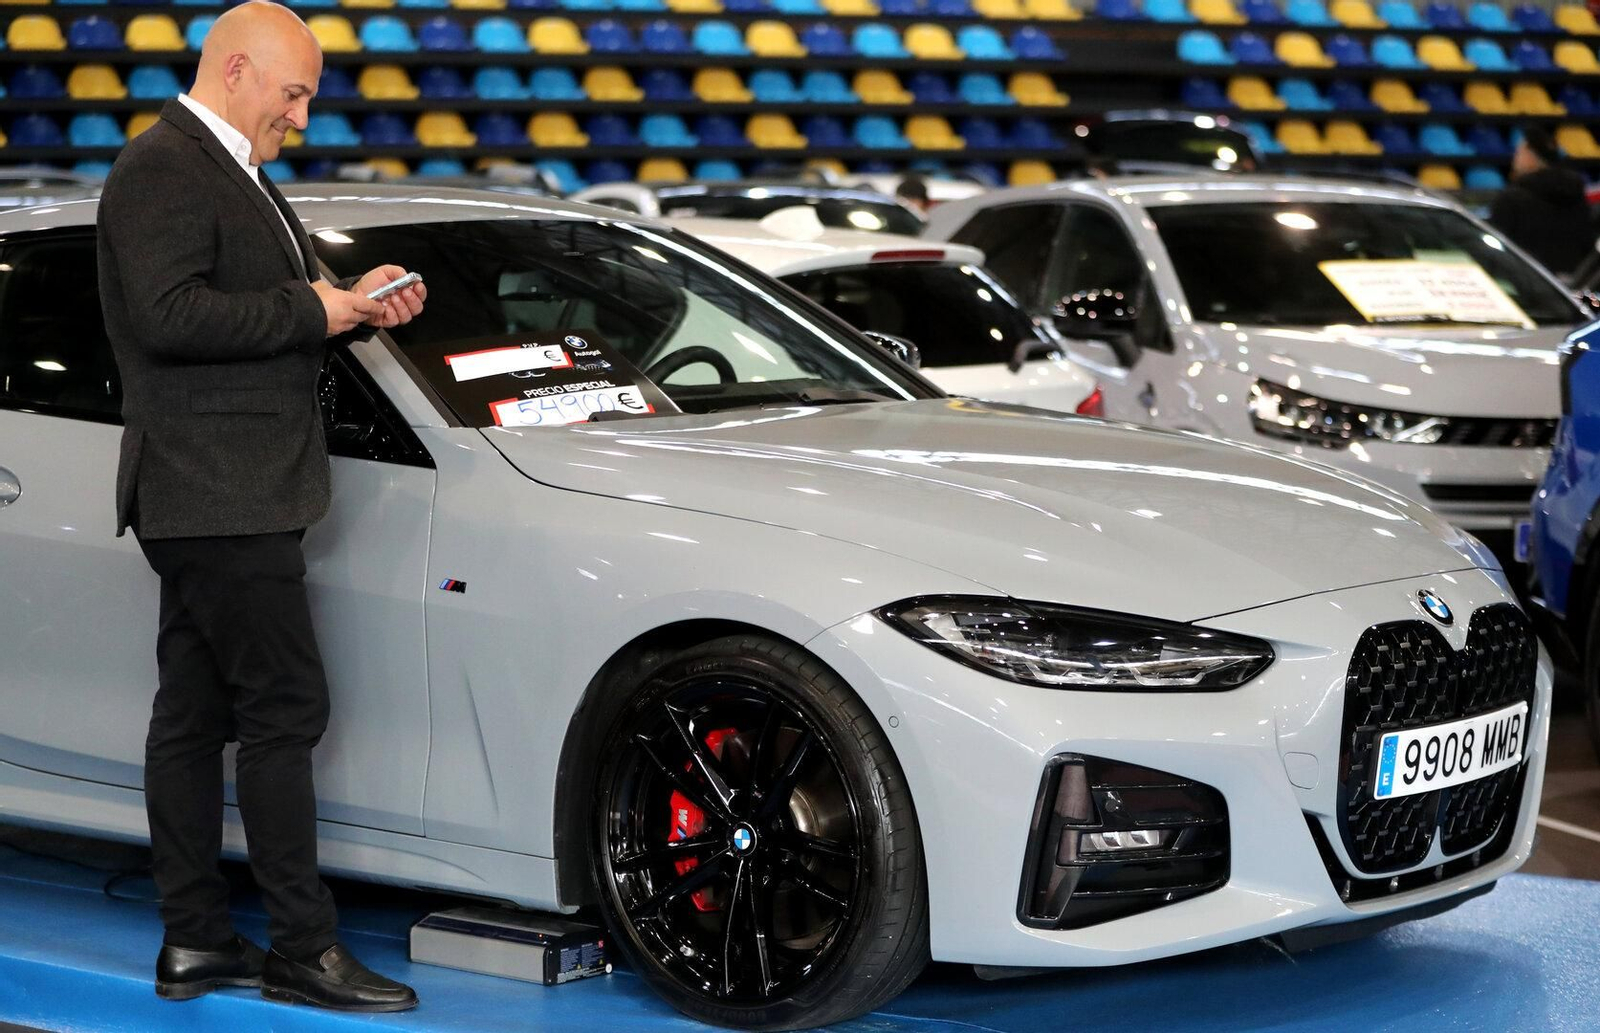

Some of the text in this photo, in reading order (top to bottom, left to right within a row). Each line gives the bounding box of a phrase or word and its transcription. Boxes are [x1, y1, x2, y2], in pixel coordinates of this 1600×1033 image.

[544, 350, 562, 362] €
[524, 380, 616, 398] PRECIO ESPECIAL
[617, 392, 644, 410] €
[1382, 714, 1520, 786] E 9908 MMB
